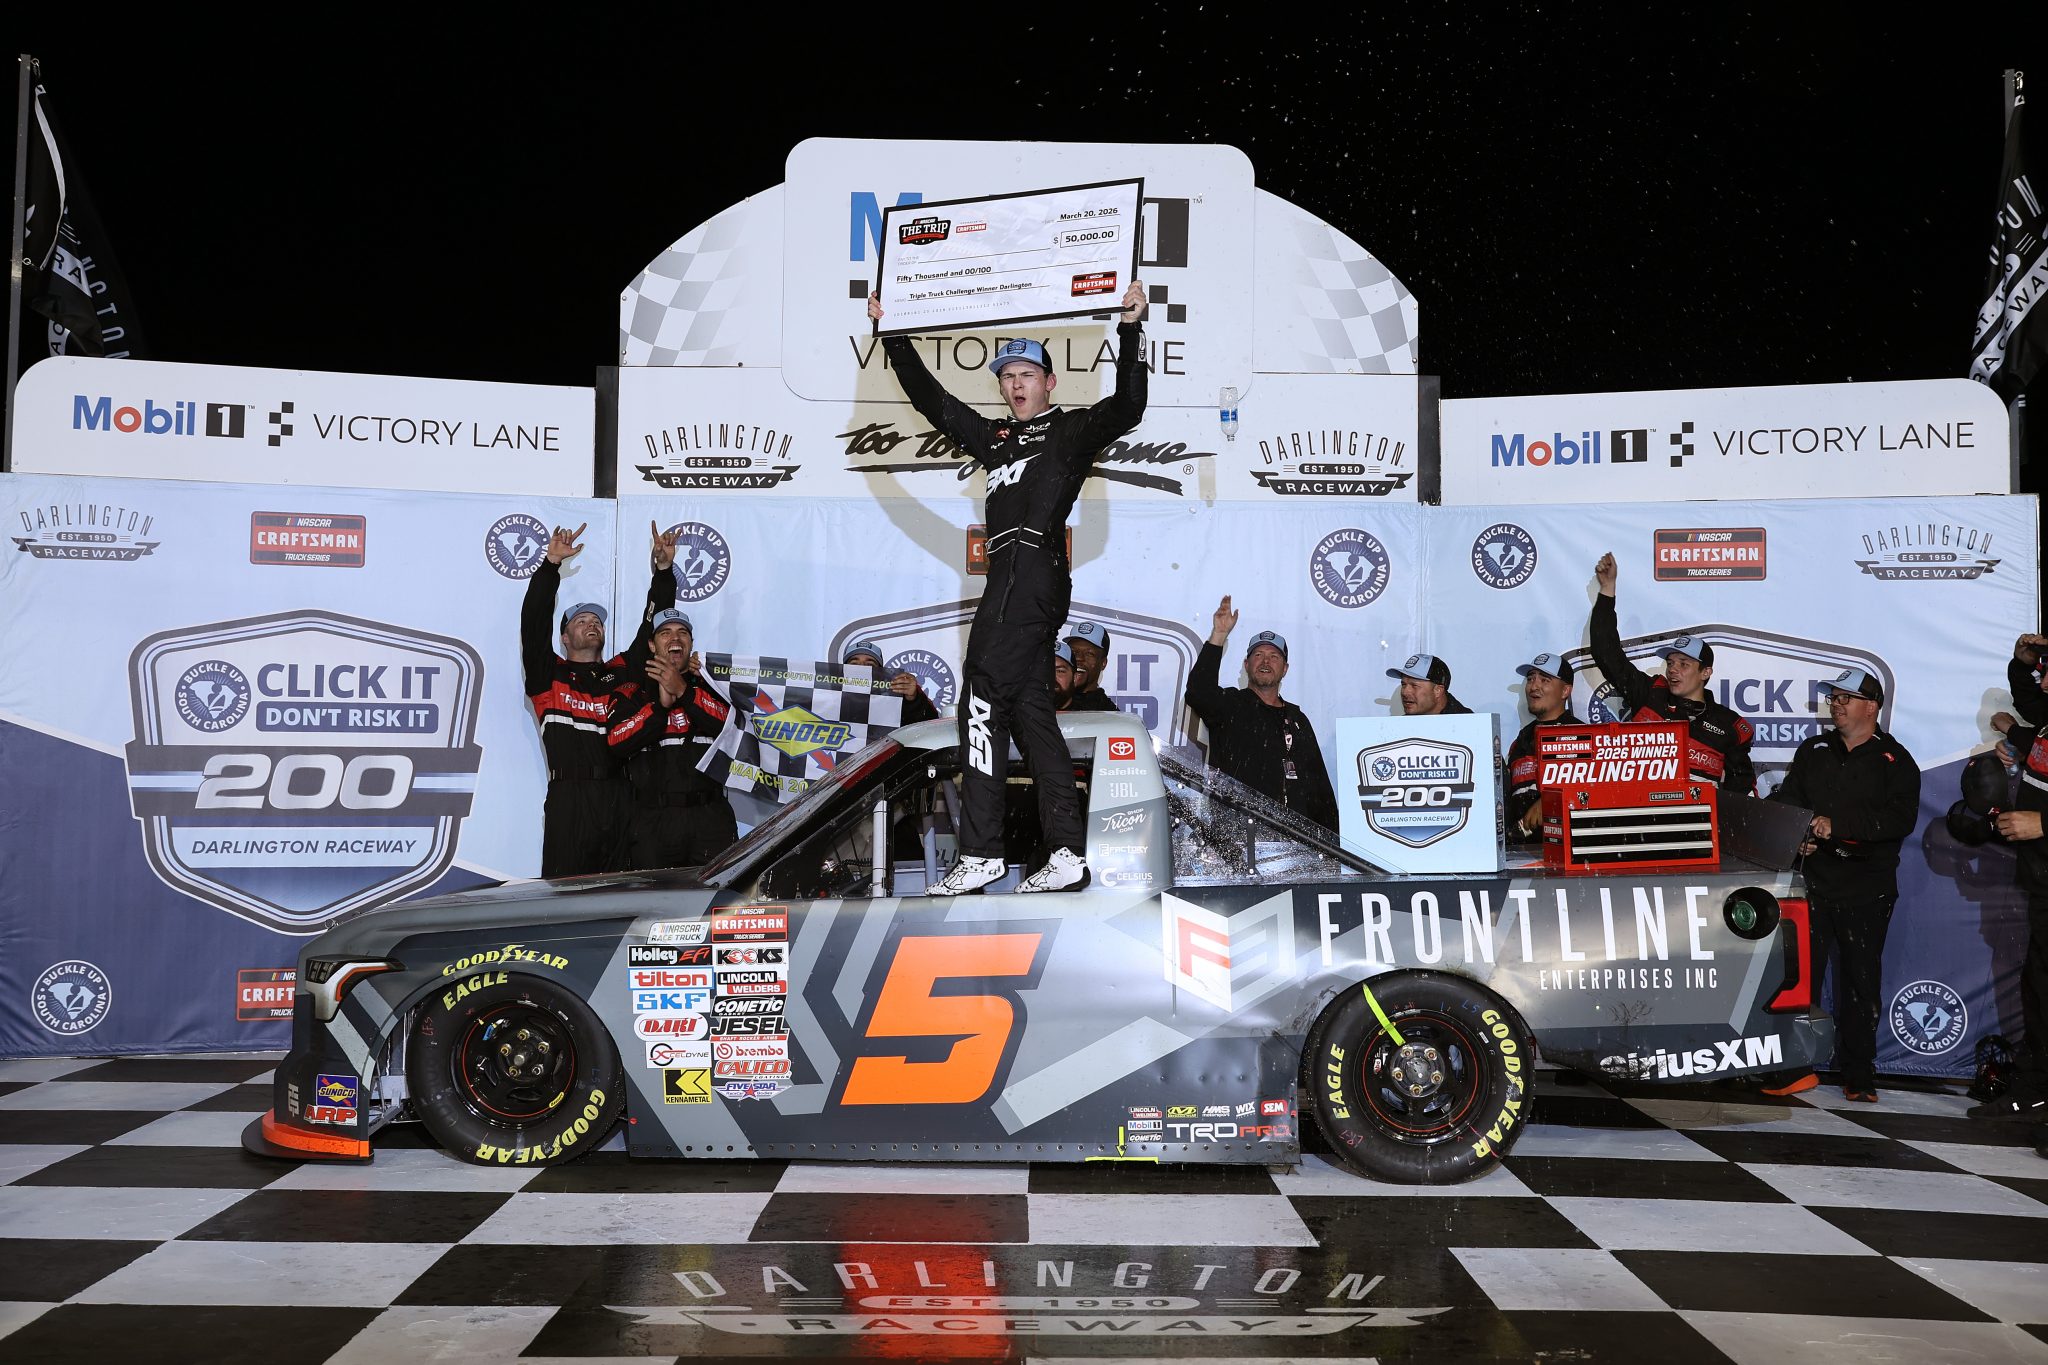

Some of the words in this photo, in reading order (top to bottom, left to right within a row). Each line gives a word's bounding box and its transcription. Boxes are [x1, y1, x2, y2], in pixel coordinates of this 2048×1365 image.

[1060, 211, 1082, 220] March
[1098, 207, 1118, 216] 2026
[901, 224, 922, 238] THE
[923, 222, 948, 234] TRIP
[956, 223, 986, 233] CRAFTSMAN
[1053, 236, 1059, 245] $
[1065, 230, 1114, 243] 50,000.00
[896, 274, 912, 283] Fifty
[915, 271, 949, 280] Thousand
[965, 266, 992, 275] 00/100
[928, 290, 944, 298] Truck
[946, 287, 975, 296] Challenge
[1000, 282, 1032, 290] Darlington
[1074, 279, 1114, 289] CRAFTSMAN
[73, 395, 196, 435] Mobil
[313, 413, 462, 446] VICTORY
[472, 423, 560, 451] LANE
[1713, 425, 1867, 456] VICTORY
[1878, 422, 1975, 451] LANE
[645, 423, 793, 459] DARLINGTON
[1259, 430, 1405, 466] DARLINGTON
[1491, 431, 1600, 467] Mobil
[689, 458, 715, 466] EST.
[1304, 465, 1328, 473] EST.
[1334, 465, 1360, 474] 1950
[670, 476, 767, 486] RACEWAY
[1286, 483, 1380, 493] RACEWAY
[20, 504, 154, 537] DARLINGTON
[297, 517, 332, 528] NASCAR
[492, 516, 531, 536] BUCKLE
[533, 522, 545, 537] UP
[61, 533, 83, 541] EST.
[88, 534, 113, 542] 1950
[257, 531, 358, 548] CRAFTSMAN
[707, 532, 722, 547] UP
[1318, 531, 1365, 555] BUCKLE
[1366, 538, 1381, 554] UP
[1478, 526, 1516, 545] BUCKLE
[1517, 531, 1530, 544] UP
[1698, 533, 1732, 542] NASCAR
[1862, 524, 1993, 555] DARLINGTON
[44, 548, 130, 559] RACEWAY
[285, 553, 307, 561] TRUCK
[307, 553, 331, 562] SERIES
[487, 541, 508, 574] SOUTH
[1660, 547, 1759, 562] CRAFTSMAN
[1474, 552, 1496, 584] SOUTH
[1496, 552, 1535, 586] CAROLINA
[1709, 568, 1732, 576] SERIES
[1885, 569, 1969, 578] RACEWAY
[680, 557, 728, 599] CAROLINA
[1313, 563, 1339, 601] SOUTH
[1341, 563, 1387, 605] CAROLINA
[183, 663, 228, 685] BUCKLE
[230, 669, 244, 685] UP
[933, 660, 948, 675] UP
[1117, 654, 1159, 692] IT
[256, 663, 389, 699] CLICK
[401, 666, 440, 699] IT
[713, 665, 755, 676] BUCKLE
[759, 669, 773, 678] UP
[776, 671, 813, 682] SOUTH
[815, 675, 870, 687] CAROLINA
[178, 691, 201, 727] SOUTH
[203, 692, 248, 730] CAROLINA
[265, 707, 342, 727] DON'T
[348, 708, 402, 727] RISK
[408, 709, 430, 728] IT
[753, 718, 846, 746] SUNOCO
[1595, 732, 1675, 747] CRAFTSMAN
[1756, 723, 1809, 742] RISK
[1542, 743, 1590, 752] CRAFTSMAN
[1595, 747, 1629, 760] 2026
[1630, 745, 1678, 759] WINNER
[1397, 755, 1440, 768] CLICK
[1445, 755, 1459, 768] IT
[728, 761, 784, 790] MARCH
[1099, 768, 1147, 776] Safelite
[1400, 771, 1426, 779] DON'T
[1542, 759, 1679, 785] DARLINGTON
[195, 753, 414, 810] 200
[1109, 782, 1138, 798] JBL
[1380, 786, 1452, 807] 200
[1651, 792, 1683, 800] CRAFTSMAN
[1101, 812, 1146, 832] Tricon
[192, 840, 320, 854] DARLINGTON
[324, 839, 418, 854] RACEWAY
[1117, 872, 1153, 881] CELSIUS
[668, 924, 702, 933] NASCAR
[715, 919, 784, 930] CRAFTSMAN
[1319, 884, 1716, 967] FRONTLINE
[651, 934, 672, 942] RACE
[674, 933, 702, 941] TRUCK
[442, 944, 569, 978] GOODYEAR
[631, 947, 679, 965] Holley
[717, 948, 784, 965] KOOKS
[42, 965, 86, 987] BUCKLE
[87, 969, 102, 984] UP
[634, 971, 708, 987] tilton
[720, 972, 775, 984] LINCOLN
[1539, 968, 1674, 991] ENTERPRISES
[1685, 967, 1719, 990] INC
[442, 971, 509, 1011] EAGLE
[732, 984, 781, 993] WELDERS
[1899, 985, 1942, 1005] BUCKLE
[1943, 991, 1957, 1006] UP
[636, 992, 707, 1010] SKF
[713, 998, 784, 1014] COMETIC
[37, 993, 60, 1029] SOUTH
[62, 992, 107, 1031] CAROLINA
[840, 933, 1043, 1106] 5
[711, 1017, 788, 1036] JESEL
[1894, 1011, 1918, 1047] SOUTH
[1919, 1015, 1963, 1051] CAROLINA
[736, 1045, 784, 1057] brembo
[716, 1060, 791, 1076] CALICO
[727, 1082, 750, 1091] FIVE
[753, 1082, 777, 1091] STAR
[1327, 1043, 1351, 1120] EAGLE
[319, 1087, 355, 1097] SUNOCO
[665, 1096, 711, 1104] KENNAMETAL
[305, 1104, 357, 1122] ARP
[1202, 1105, 1231, 1114] HMS
[1235, 1101, 1256, 1114] WIX
[1263, 1102, 1284, 1113] SEM
[476, 1089, 606, 1164] GOODYEAR
[1129, 1120, 1152, 1129] Mobil
[1166, 1122, 1237, 1143] TRD
[1239, 1124, 1292, 1138] PRO
[1129, 1133, 1162, 1142] COMETIC
[672, 1260, 1385, 1300] DARLINGTON
[888, 1298, 1006, 1307] EST.
[1043, 1298, 1171, 1308] 1950
[786, 1317, 1279, 1332] RACEWAY
